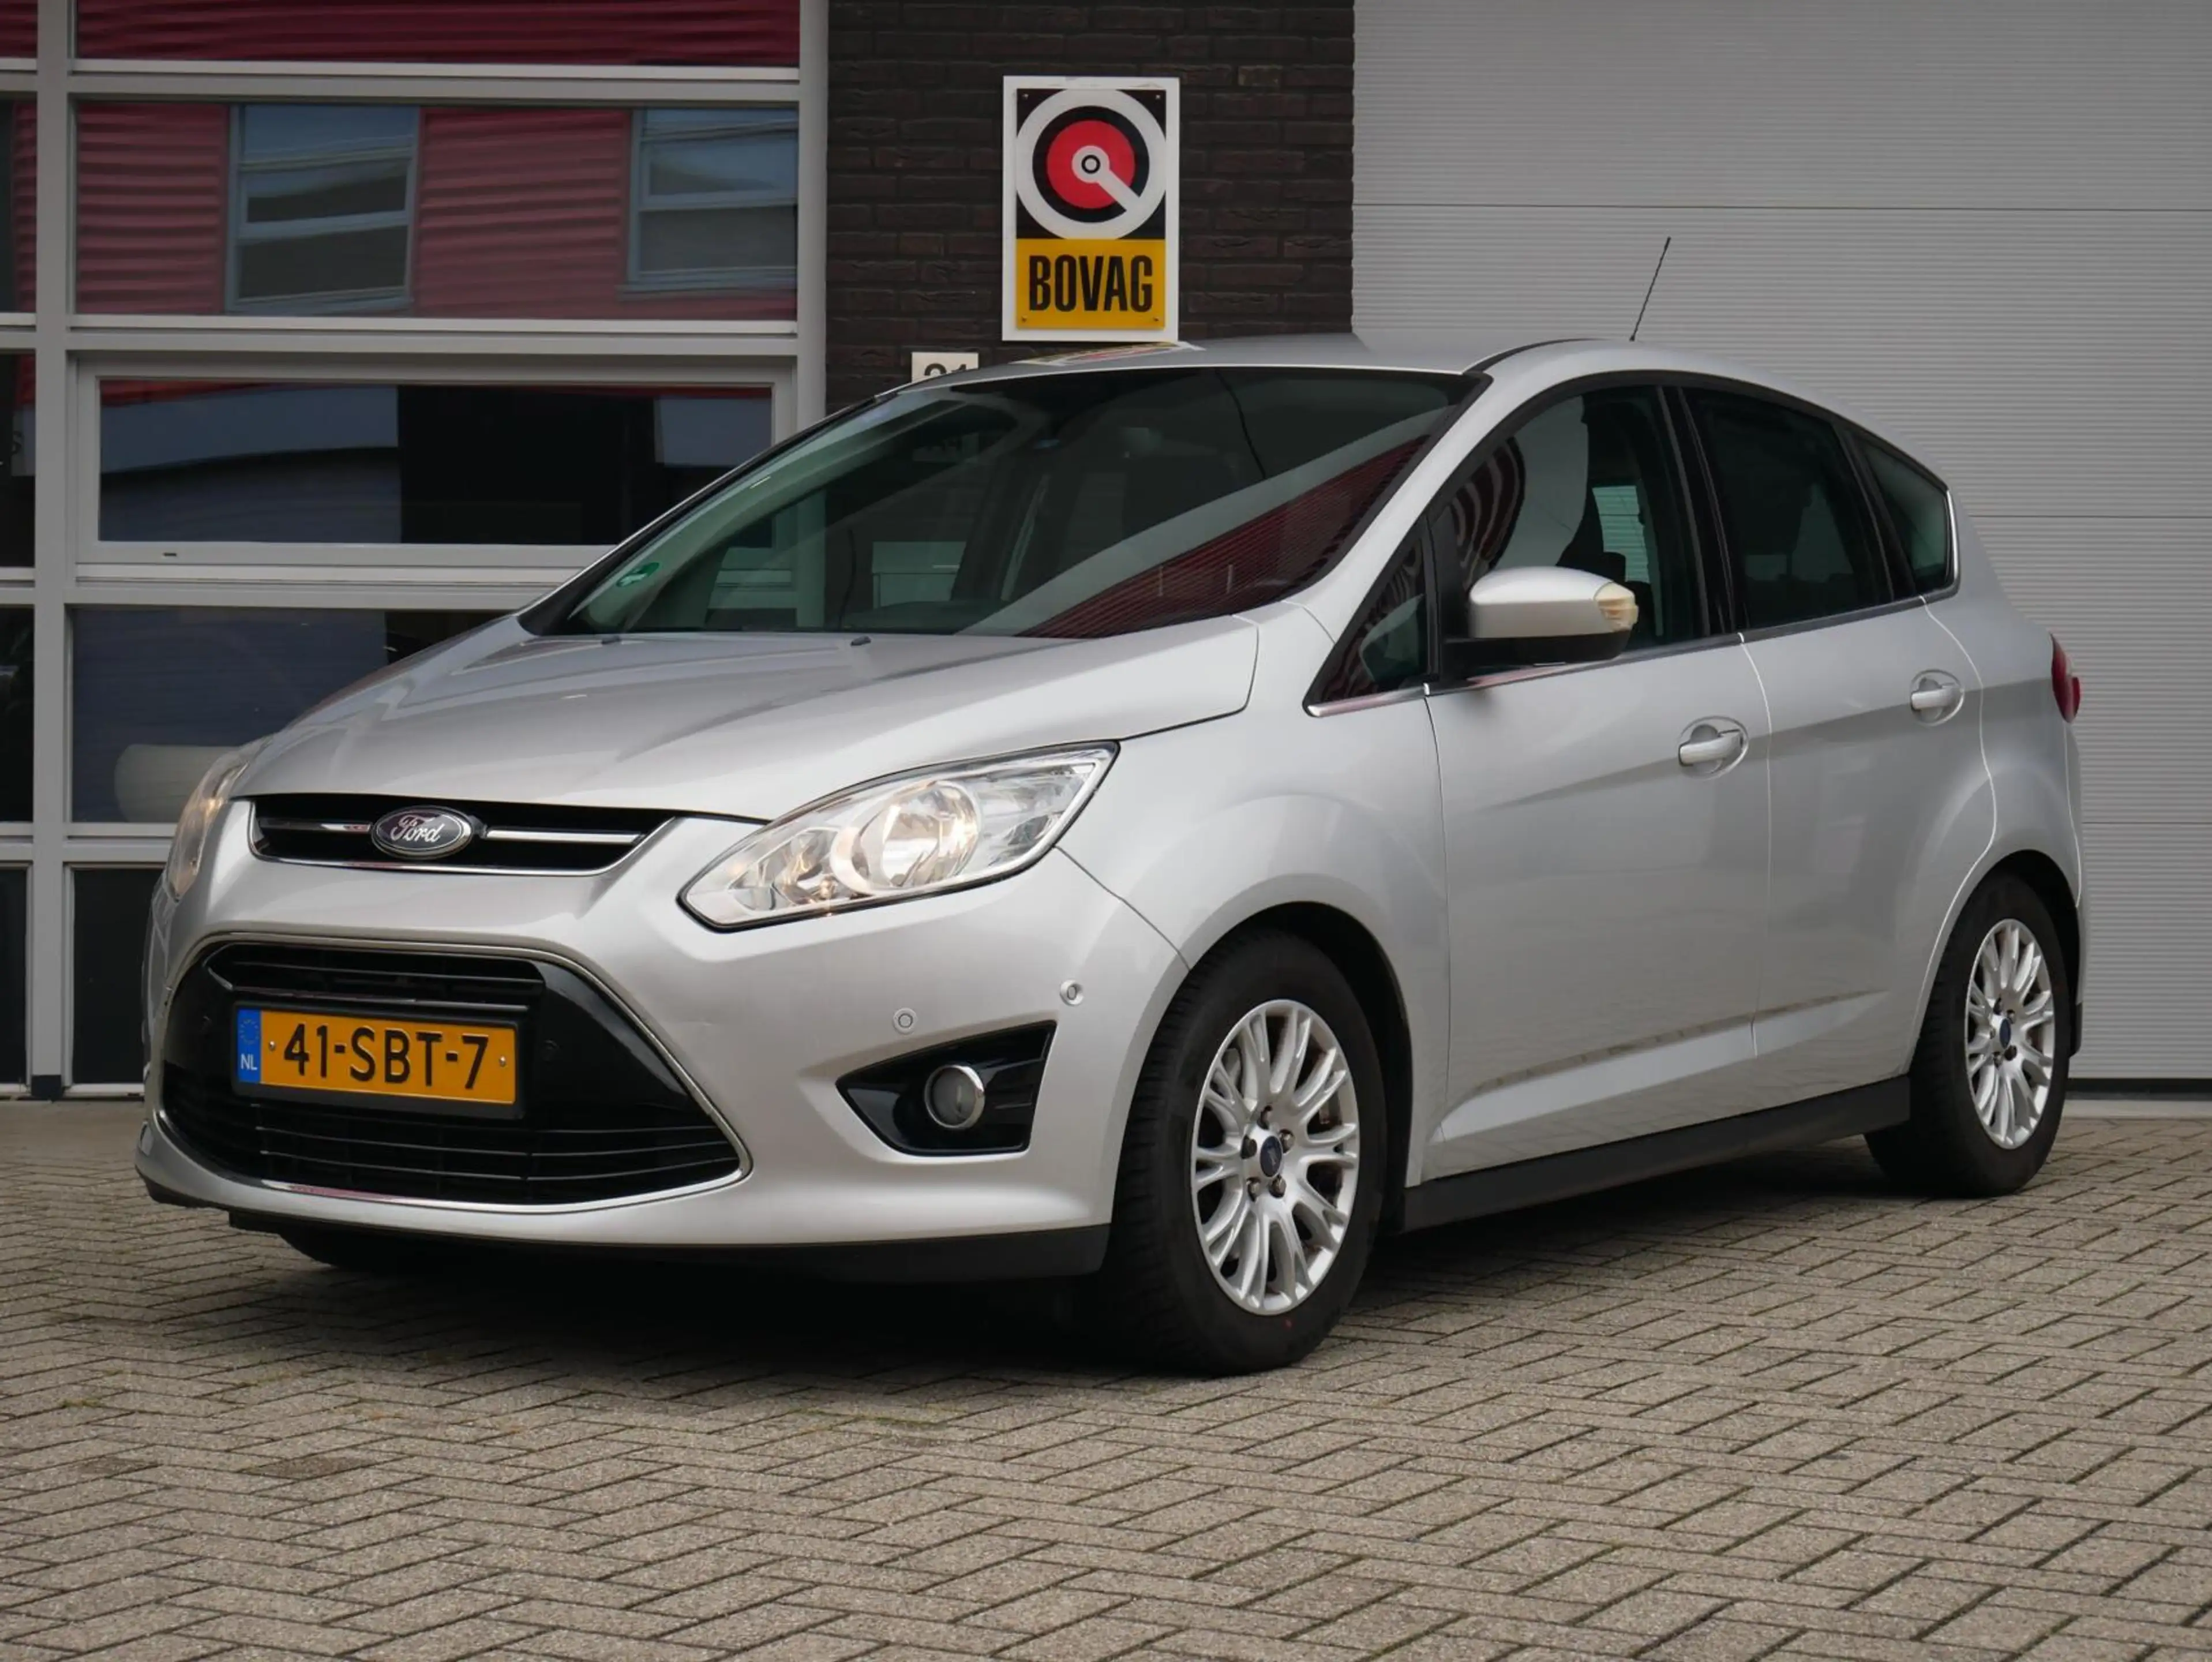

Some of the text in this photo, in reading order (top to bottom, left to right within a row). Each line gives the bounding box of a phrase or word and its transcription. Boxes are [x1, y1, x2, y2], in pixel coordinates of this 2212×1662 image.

[1029, 254, 1153, 312] BOVAG
[390, 814, 445, 843] Ford
[241, 1054, 257, 1070] NL
[283, 1023, 489, 1090] 41-SBT-7
